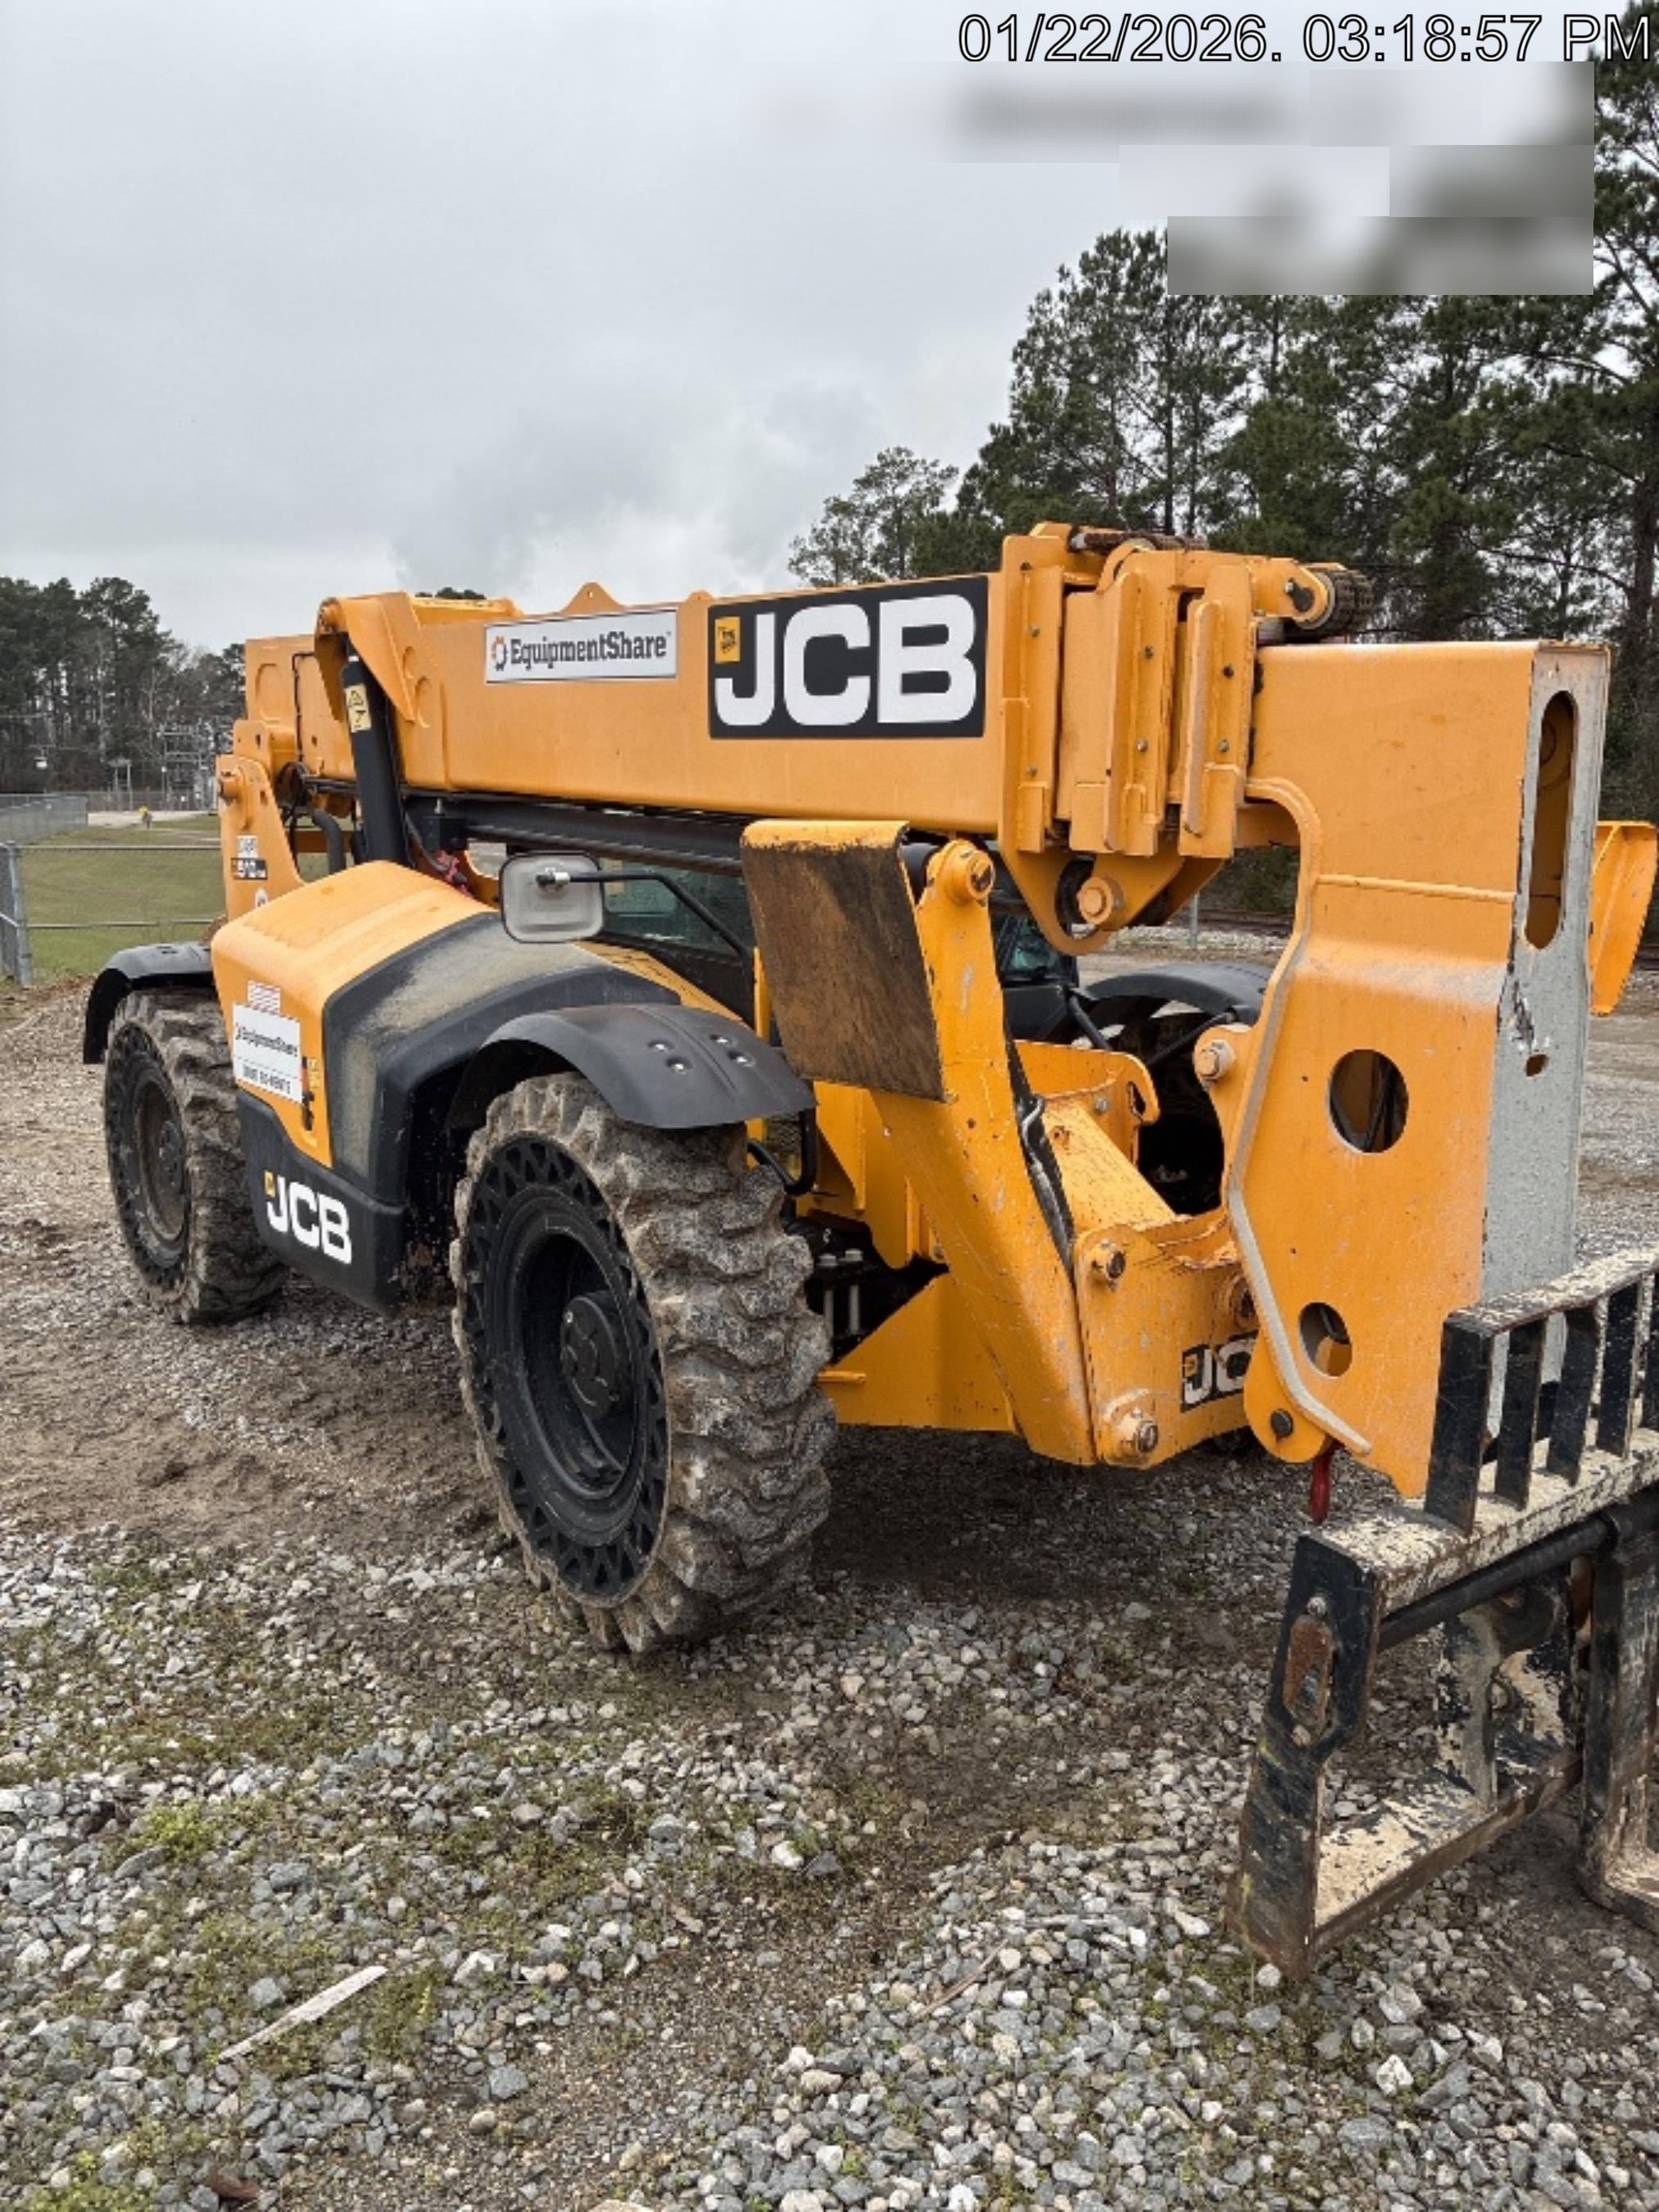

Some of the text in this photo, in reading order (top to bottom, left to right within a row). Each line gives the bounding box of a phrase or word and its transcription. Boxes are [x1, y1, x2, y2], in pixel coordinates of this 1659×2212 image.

[510, 632, 667, 671] EquipmentShare
[715, 595, 977, 726] JCB
[266, 1175, 352, 1264] JCB
[1184, 1338, 1257, 1404] JC
